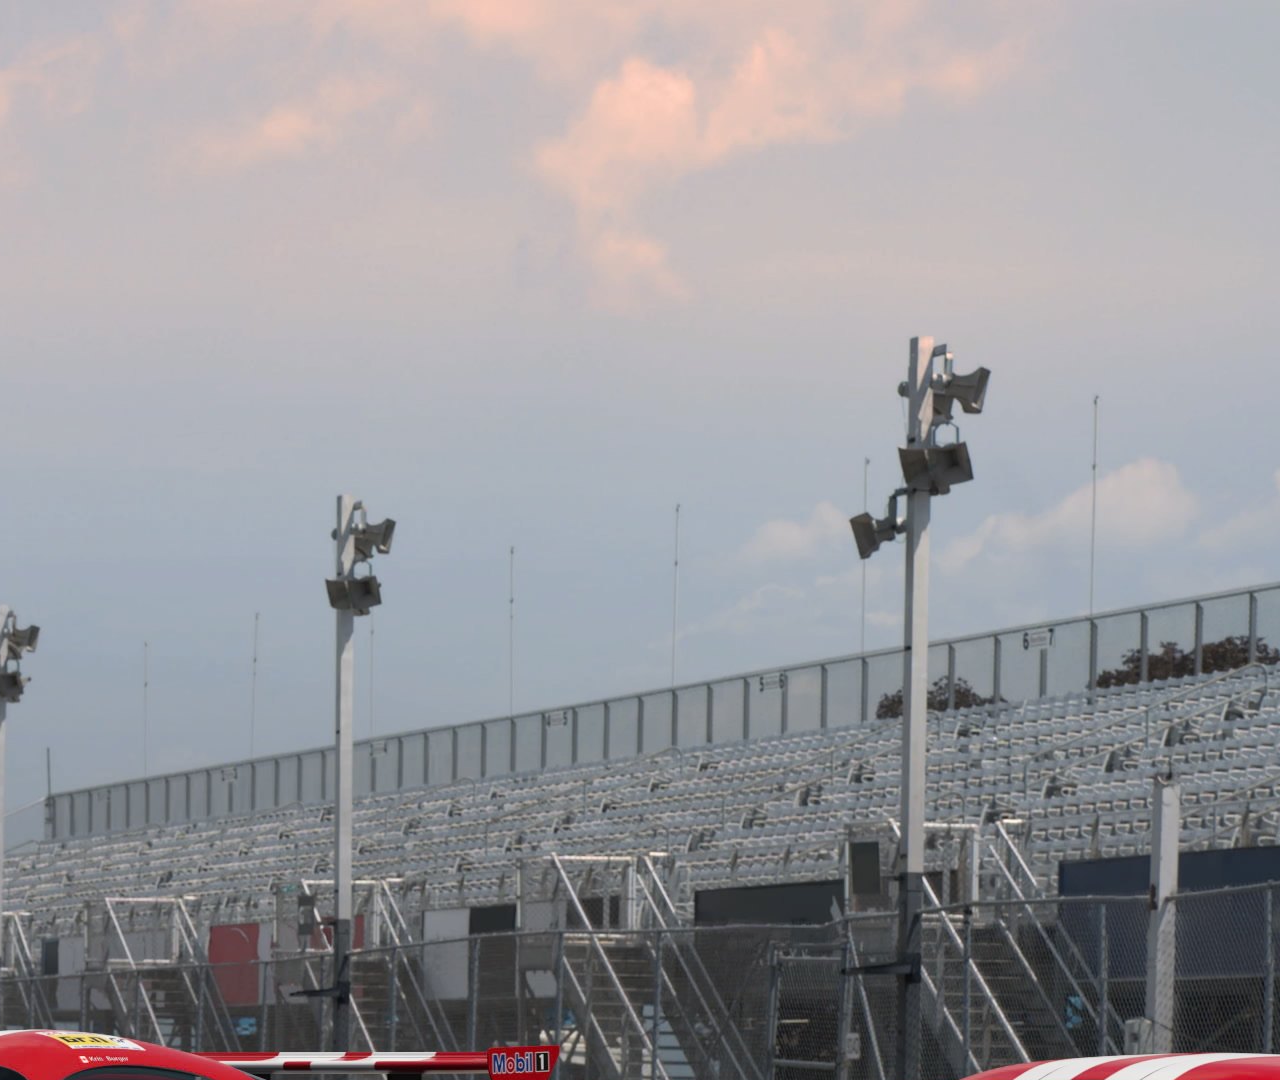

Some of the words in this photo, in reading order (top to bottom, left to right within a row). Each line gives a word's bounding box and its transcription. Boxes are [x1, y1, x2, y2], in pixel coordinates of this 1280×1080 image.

[1023, 631, 1030, 650] 6
[1048, 628, 1055, 646] 7
[492, 1051, 533, 1074] Mobil
